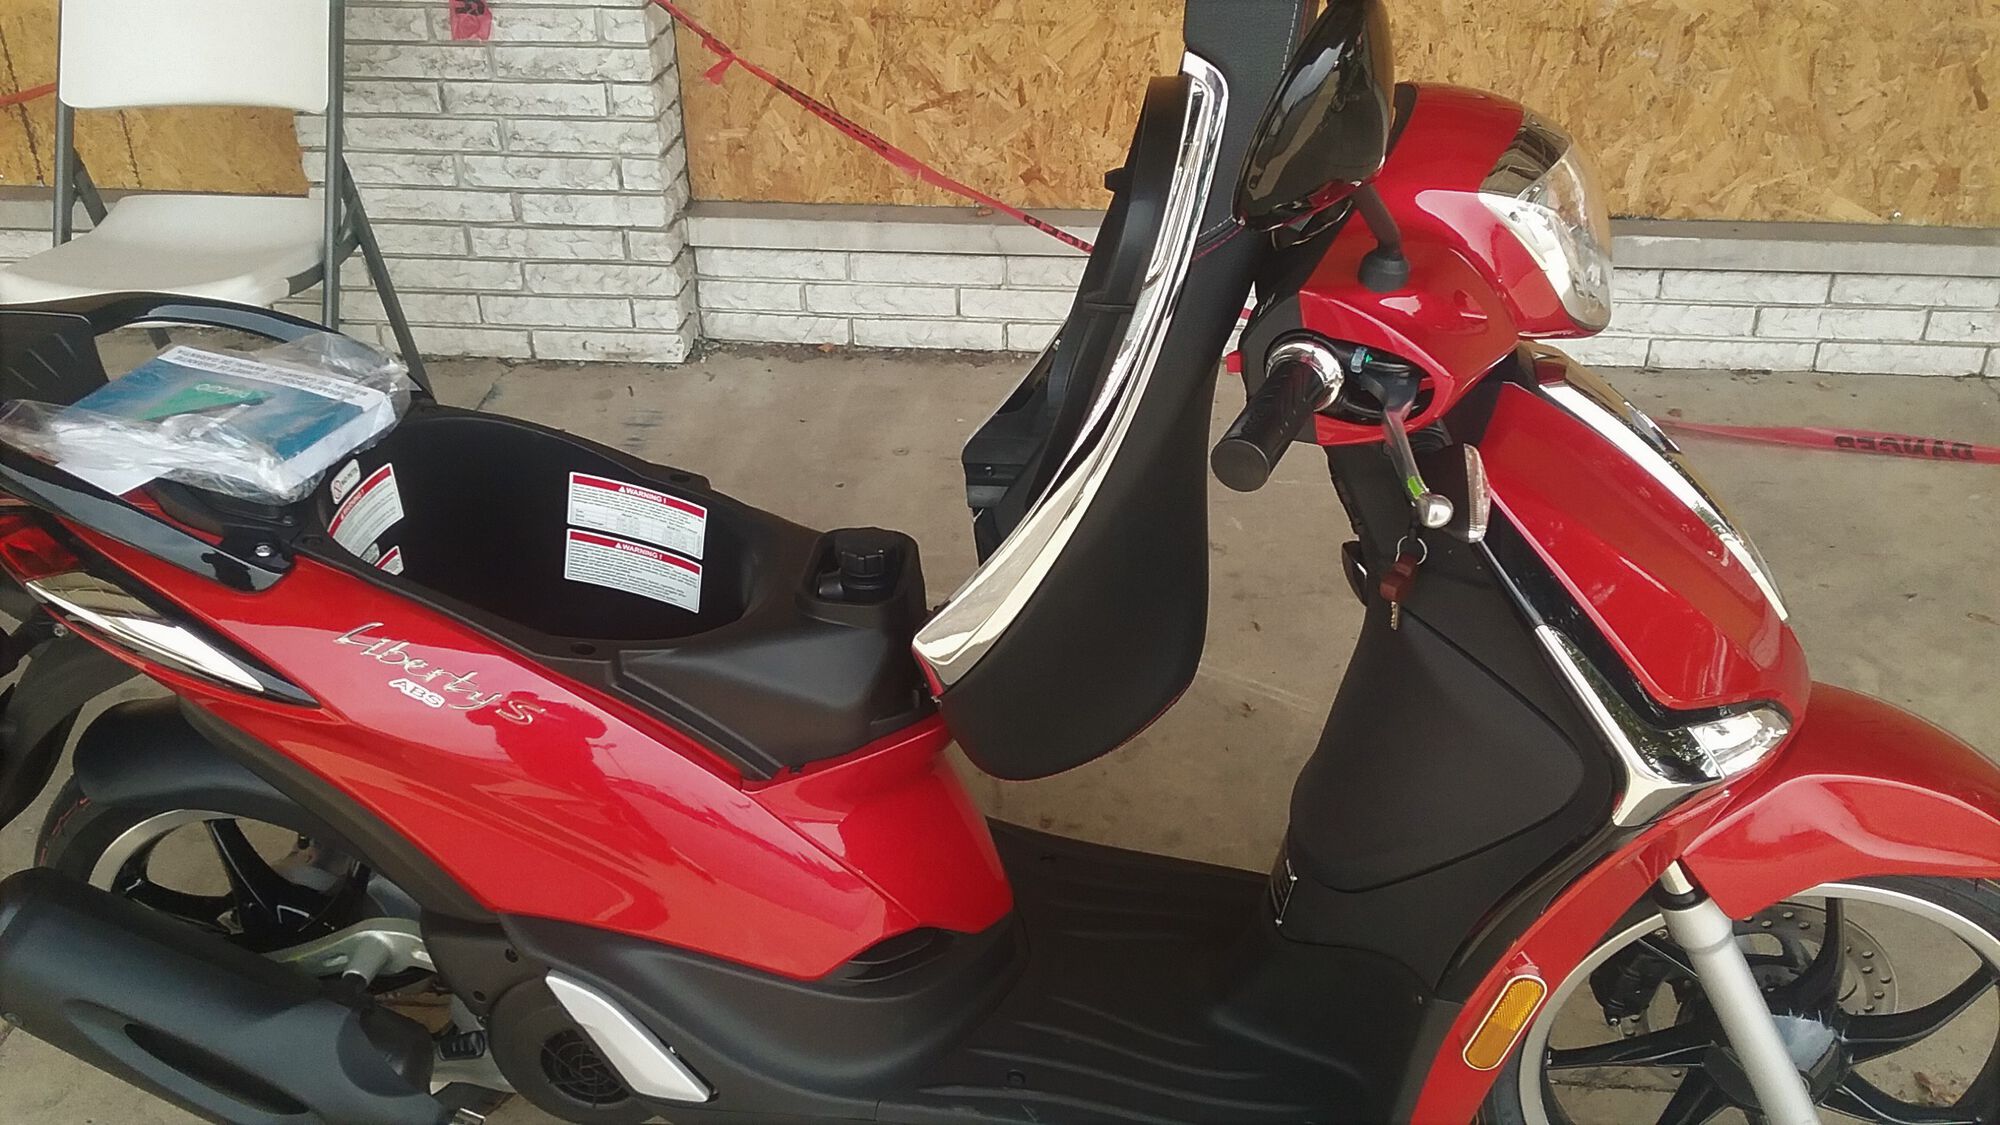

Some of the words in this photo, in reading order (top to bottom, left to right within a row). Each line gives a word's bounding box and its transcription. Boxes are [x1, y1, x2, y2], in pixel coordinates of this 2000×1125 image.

[625, 487, 662, 503] WARNING
[621, 543, 658, 559] WARNING
[333, 622, 502, 709] Liberty
[390, 678, 443, 707] ABS
